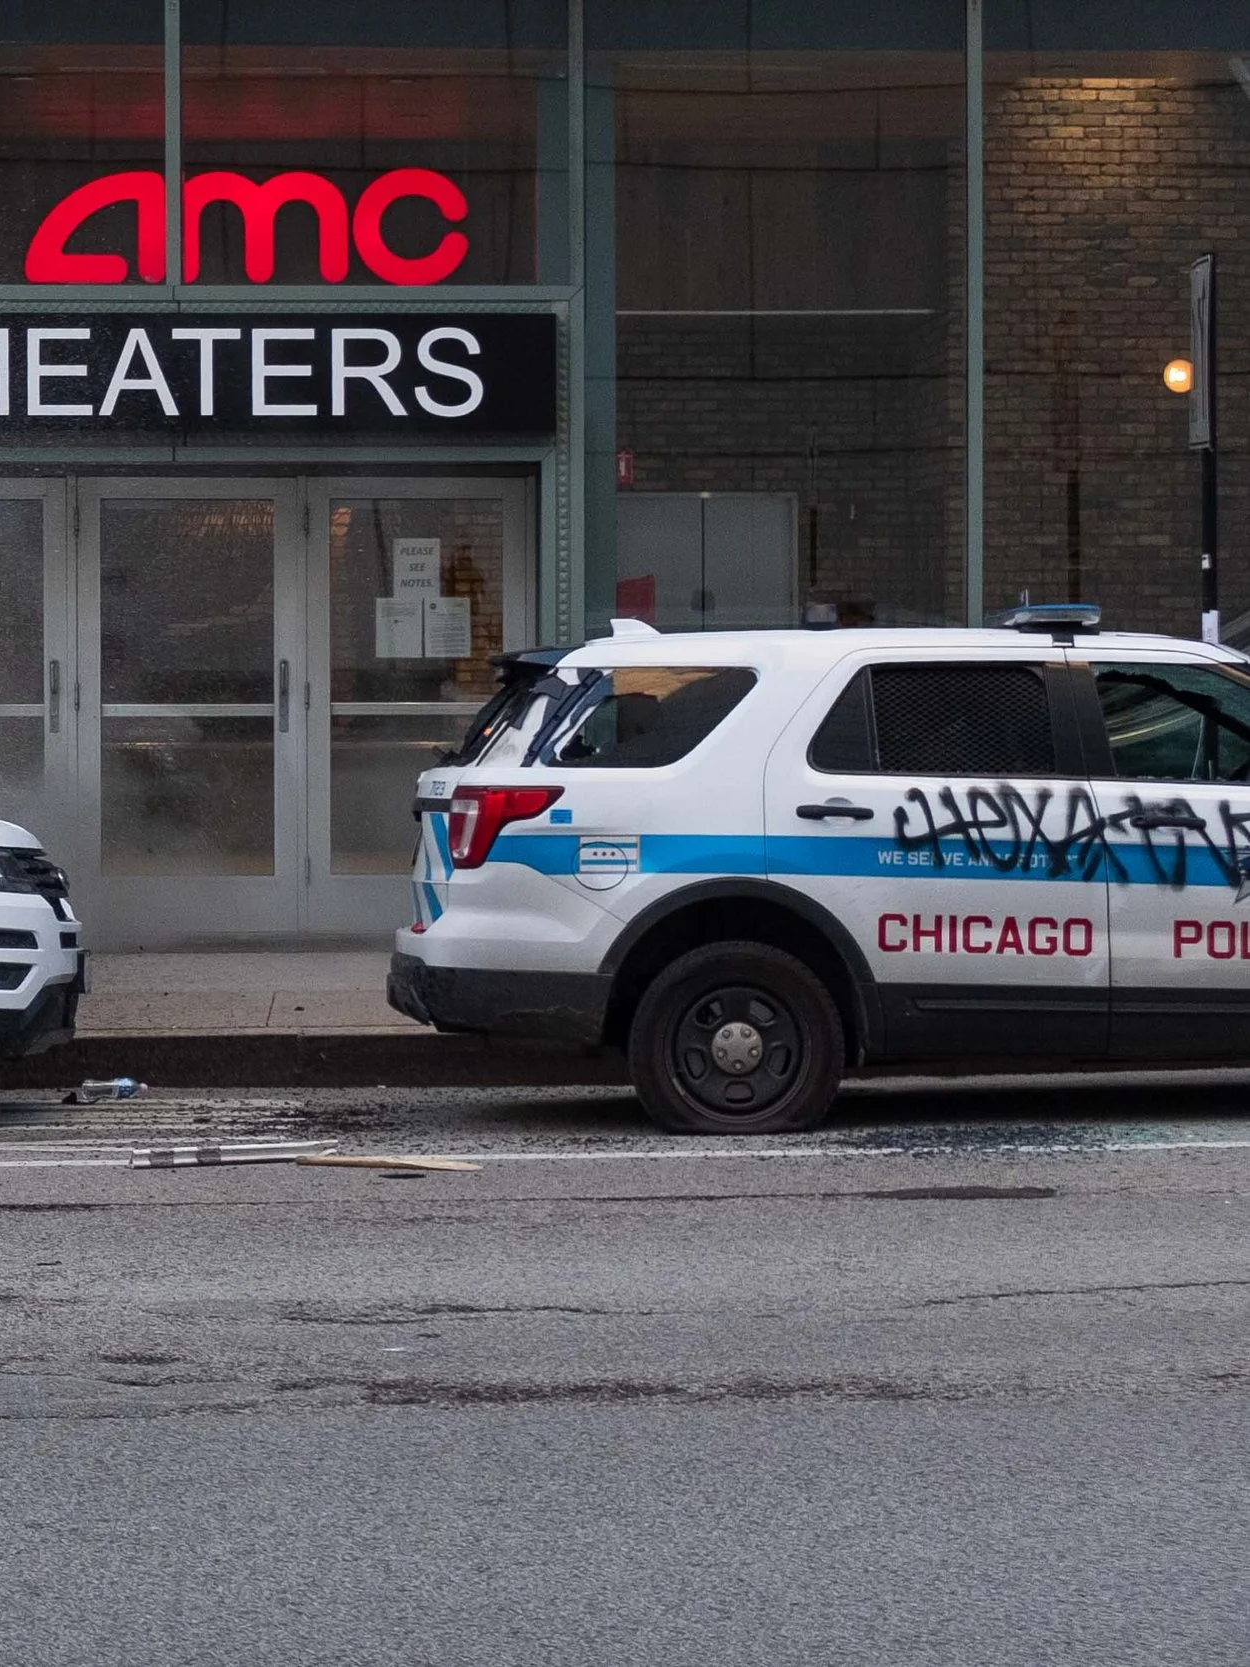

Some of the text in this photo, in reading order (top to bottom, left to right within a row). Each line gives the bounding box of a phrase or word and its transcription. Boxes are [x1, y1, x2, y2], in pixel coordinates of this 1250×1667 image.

[399, 546, 435, 556] PLEASE
[409, 563, 426, 572] SEE
[877, 850, 904, 866] WE
[907, 851, 964, 867] SEVE
[878, 913, 1093, 956] CHICAGO
